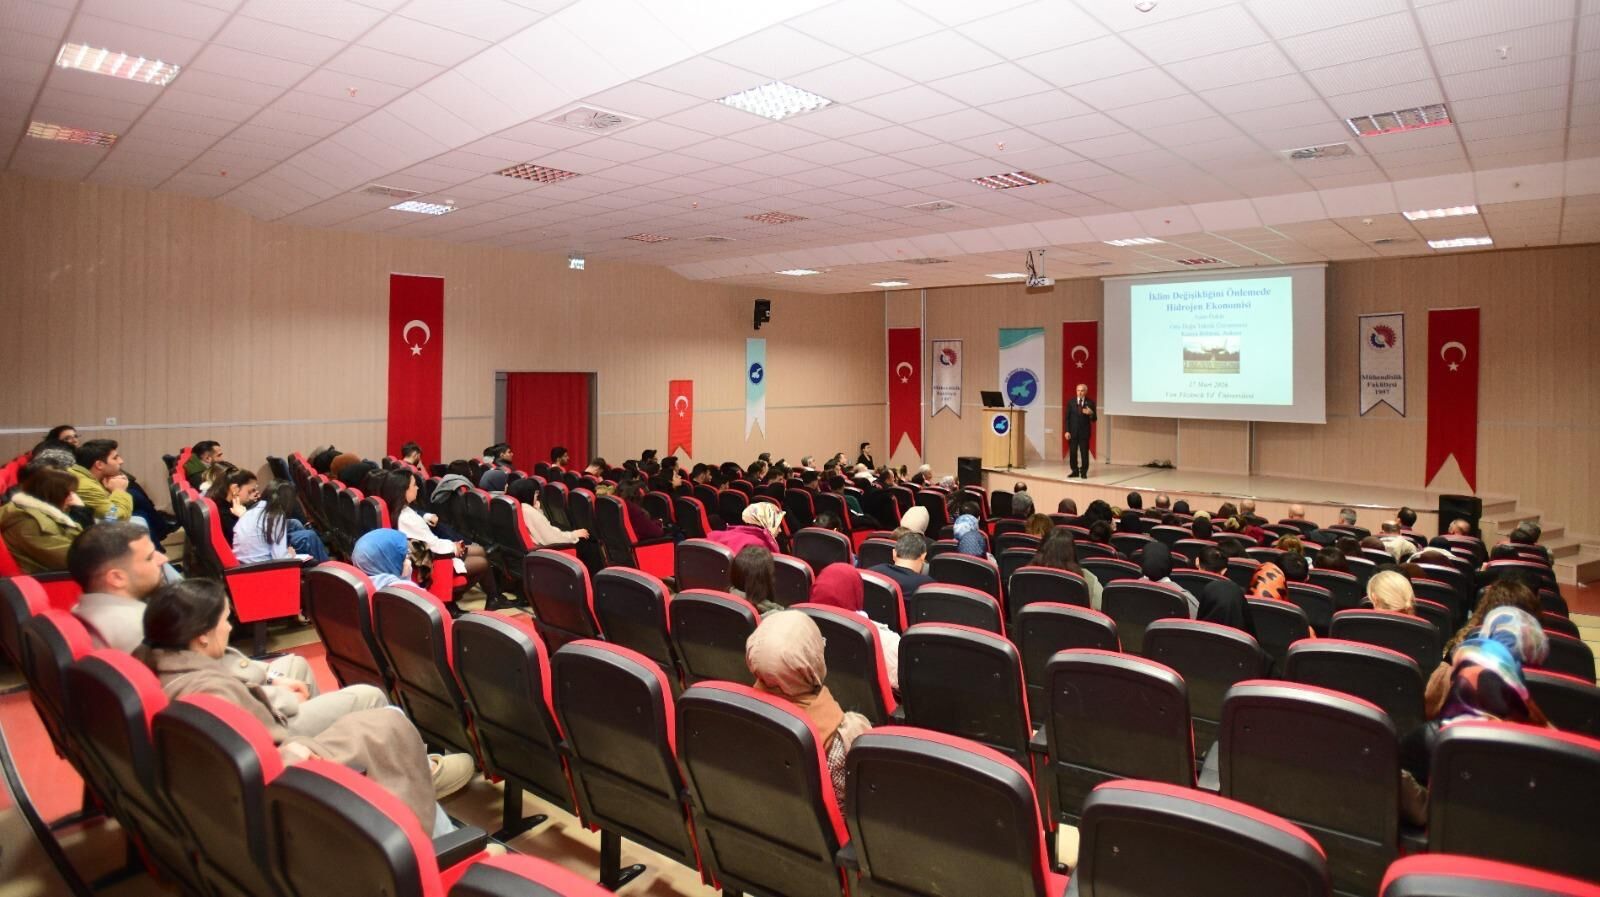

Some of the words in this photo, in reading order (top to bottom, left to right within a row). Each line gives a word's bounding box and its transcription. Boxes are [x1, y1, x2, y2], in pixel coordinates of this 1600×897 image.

[1149, 291, 1170, 301] İklim
[1172, 289, 1224, 301] Değişikliğini
[1226, 287, 1271, 297] Önlemede
[1166, 303, 1203, 312] Hidrojen
[1205, 300, 1251, 310] Ekonomisi
